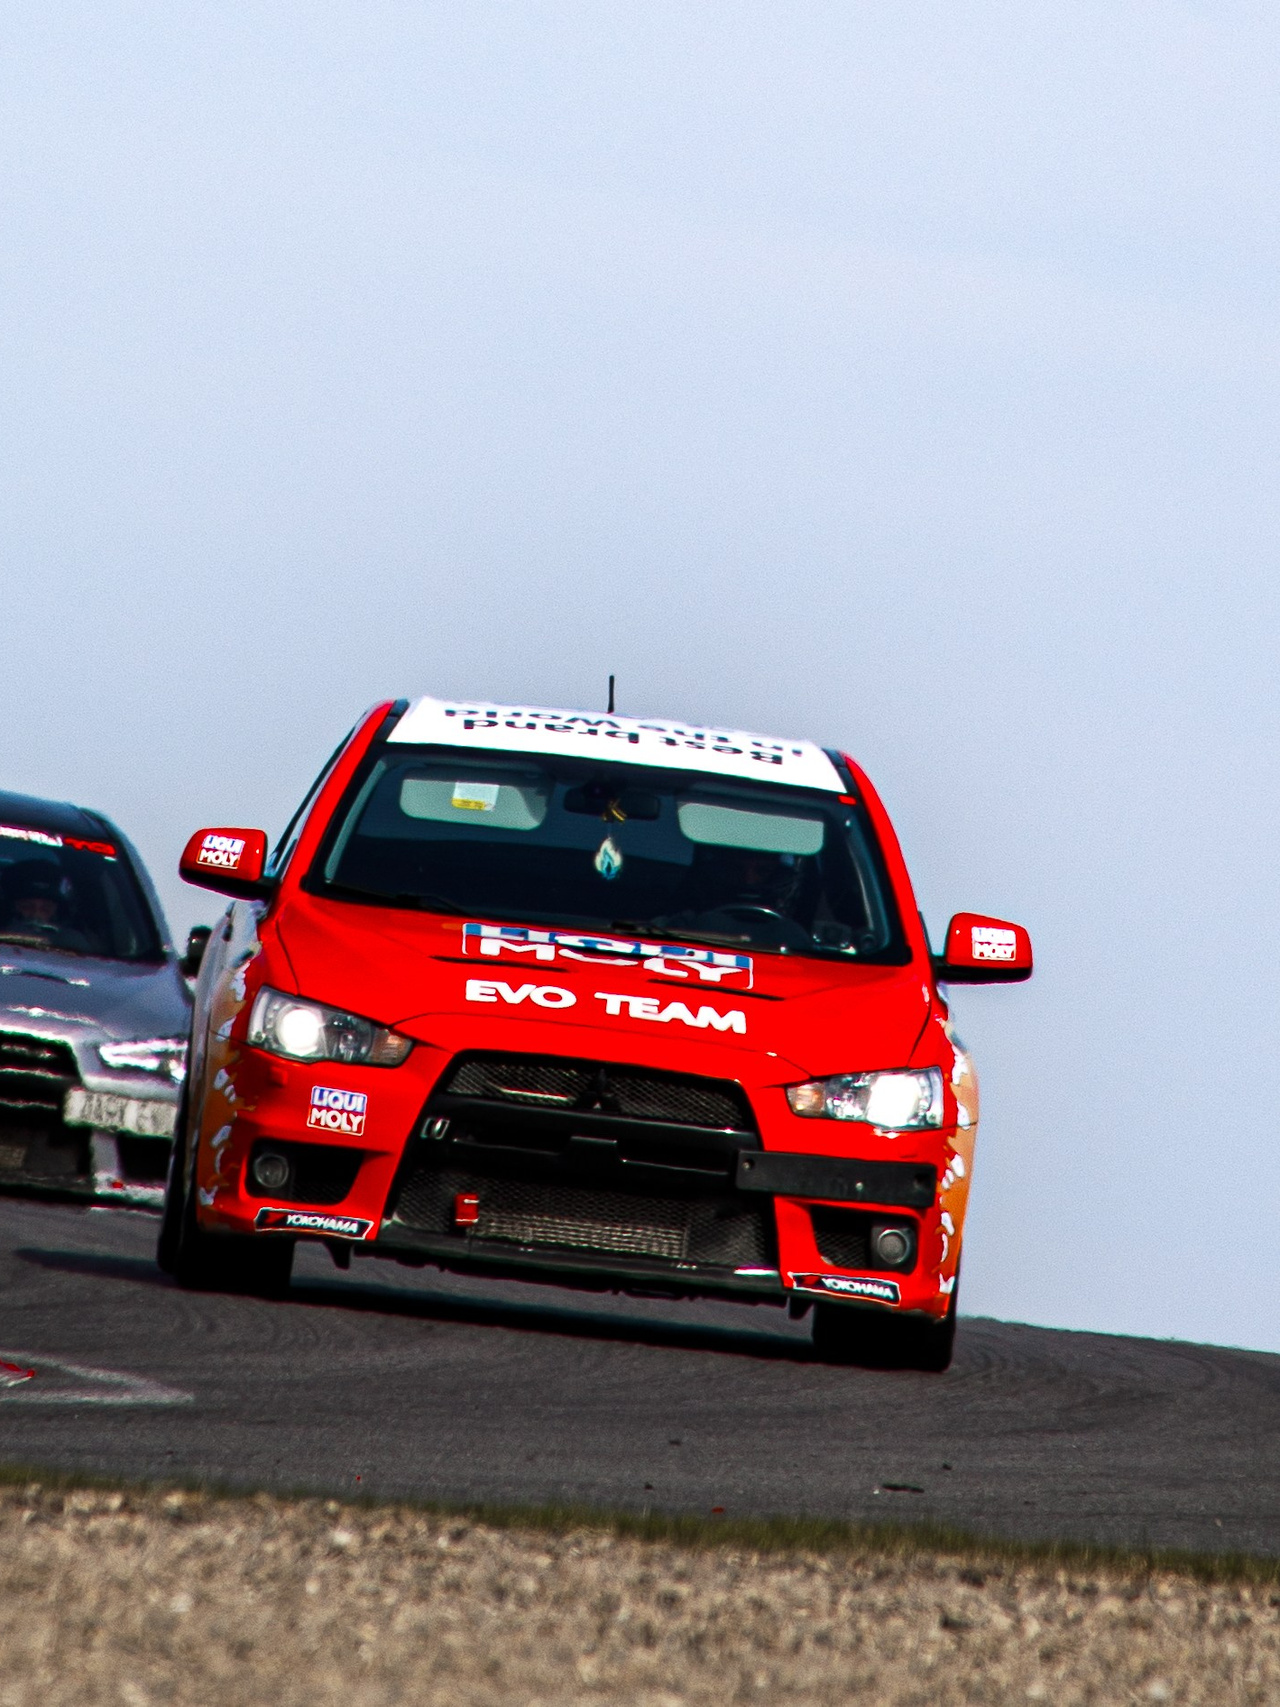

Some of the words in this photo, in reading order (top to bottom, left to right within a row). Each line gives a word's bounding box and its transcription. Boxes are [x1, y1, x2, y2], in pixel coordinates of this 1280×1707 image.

[463, 719, 639, 744] brand
[659, 736, 783, 765] Best
[199, 848, 239, 867] MOLY
[465, 978, 577, 1009] EVO
[594, 992, 747, 1034] TEAM
[313, 1088, 365, 1113] LIQUI
[310, 1107, 364, 1132] MOLY
[286, 1213, 359, 1233] YOKOHAMA
[821, 1278, 895, 1299] YOKOHAMA
